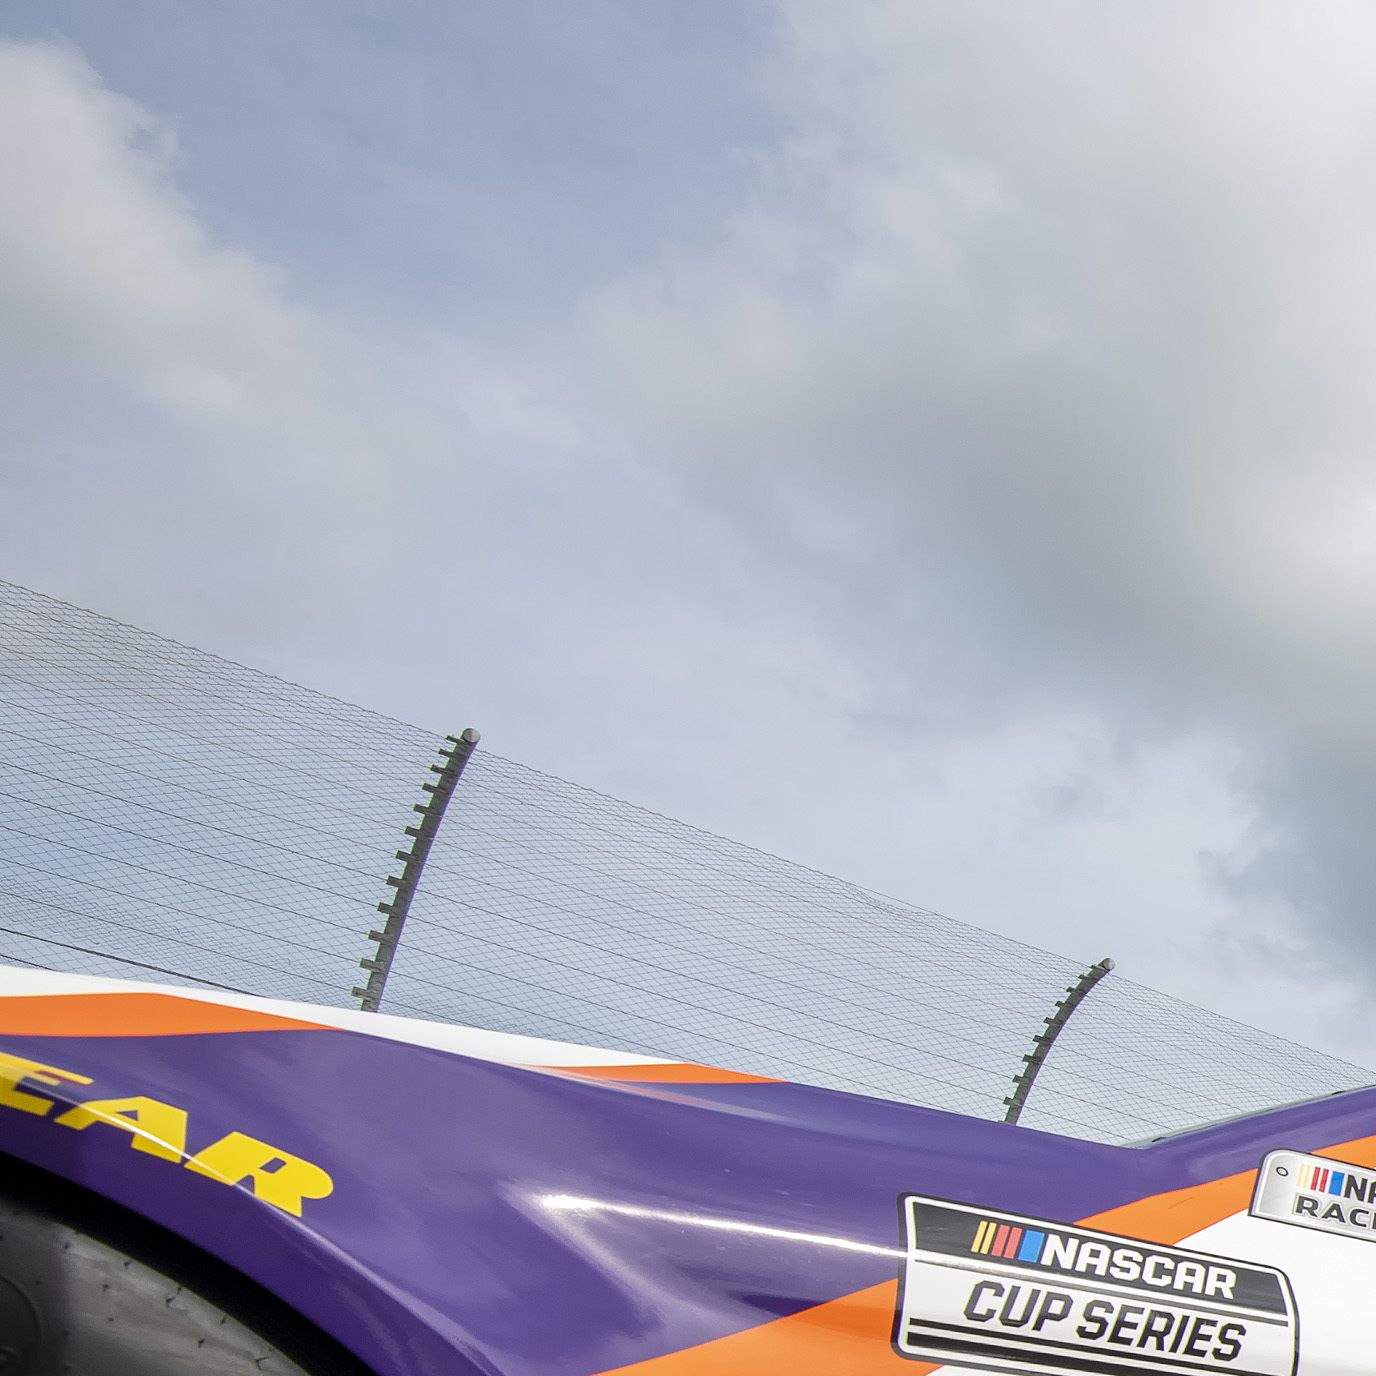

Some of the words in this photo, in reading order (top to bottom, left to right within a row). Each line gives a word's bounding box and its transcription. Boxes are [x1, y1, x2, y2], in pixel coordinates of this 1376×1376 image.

[1042, 1234, 1238, 1299] NASCAR
[963, 1279, 1072, 1332] CUP
[1076, 1300, 1247, 1363] SERIES
